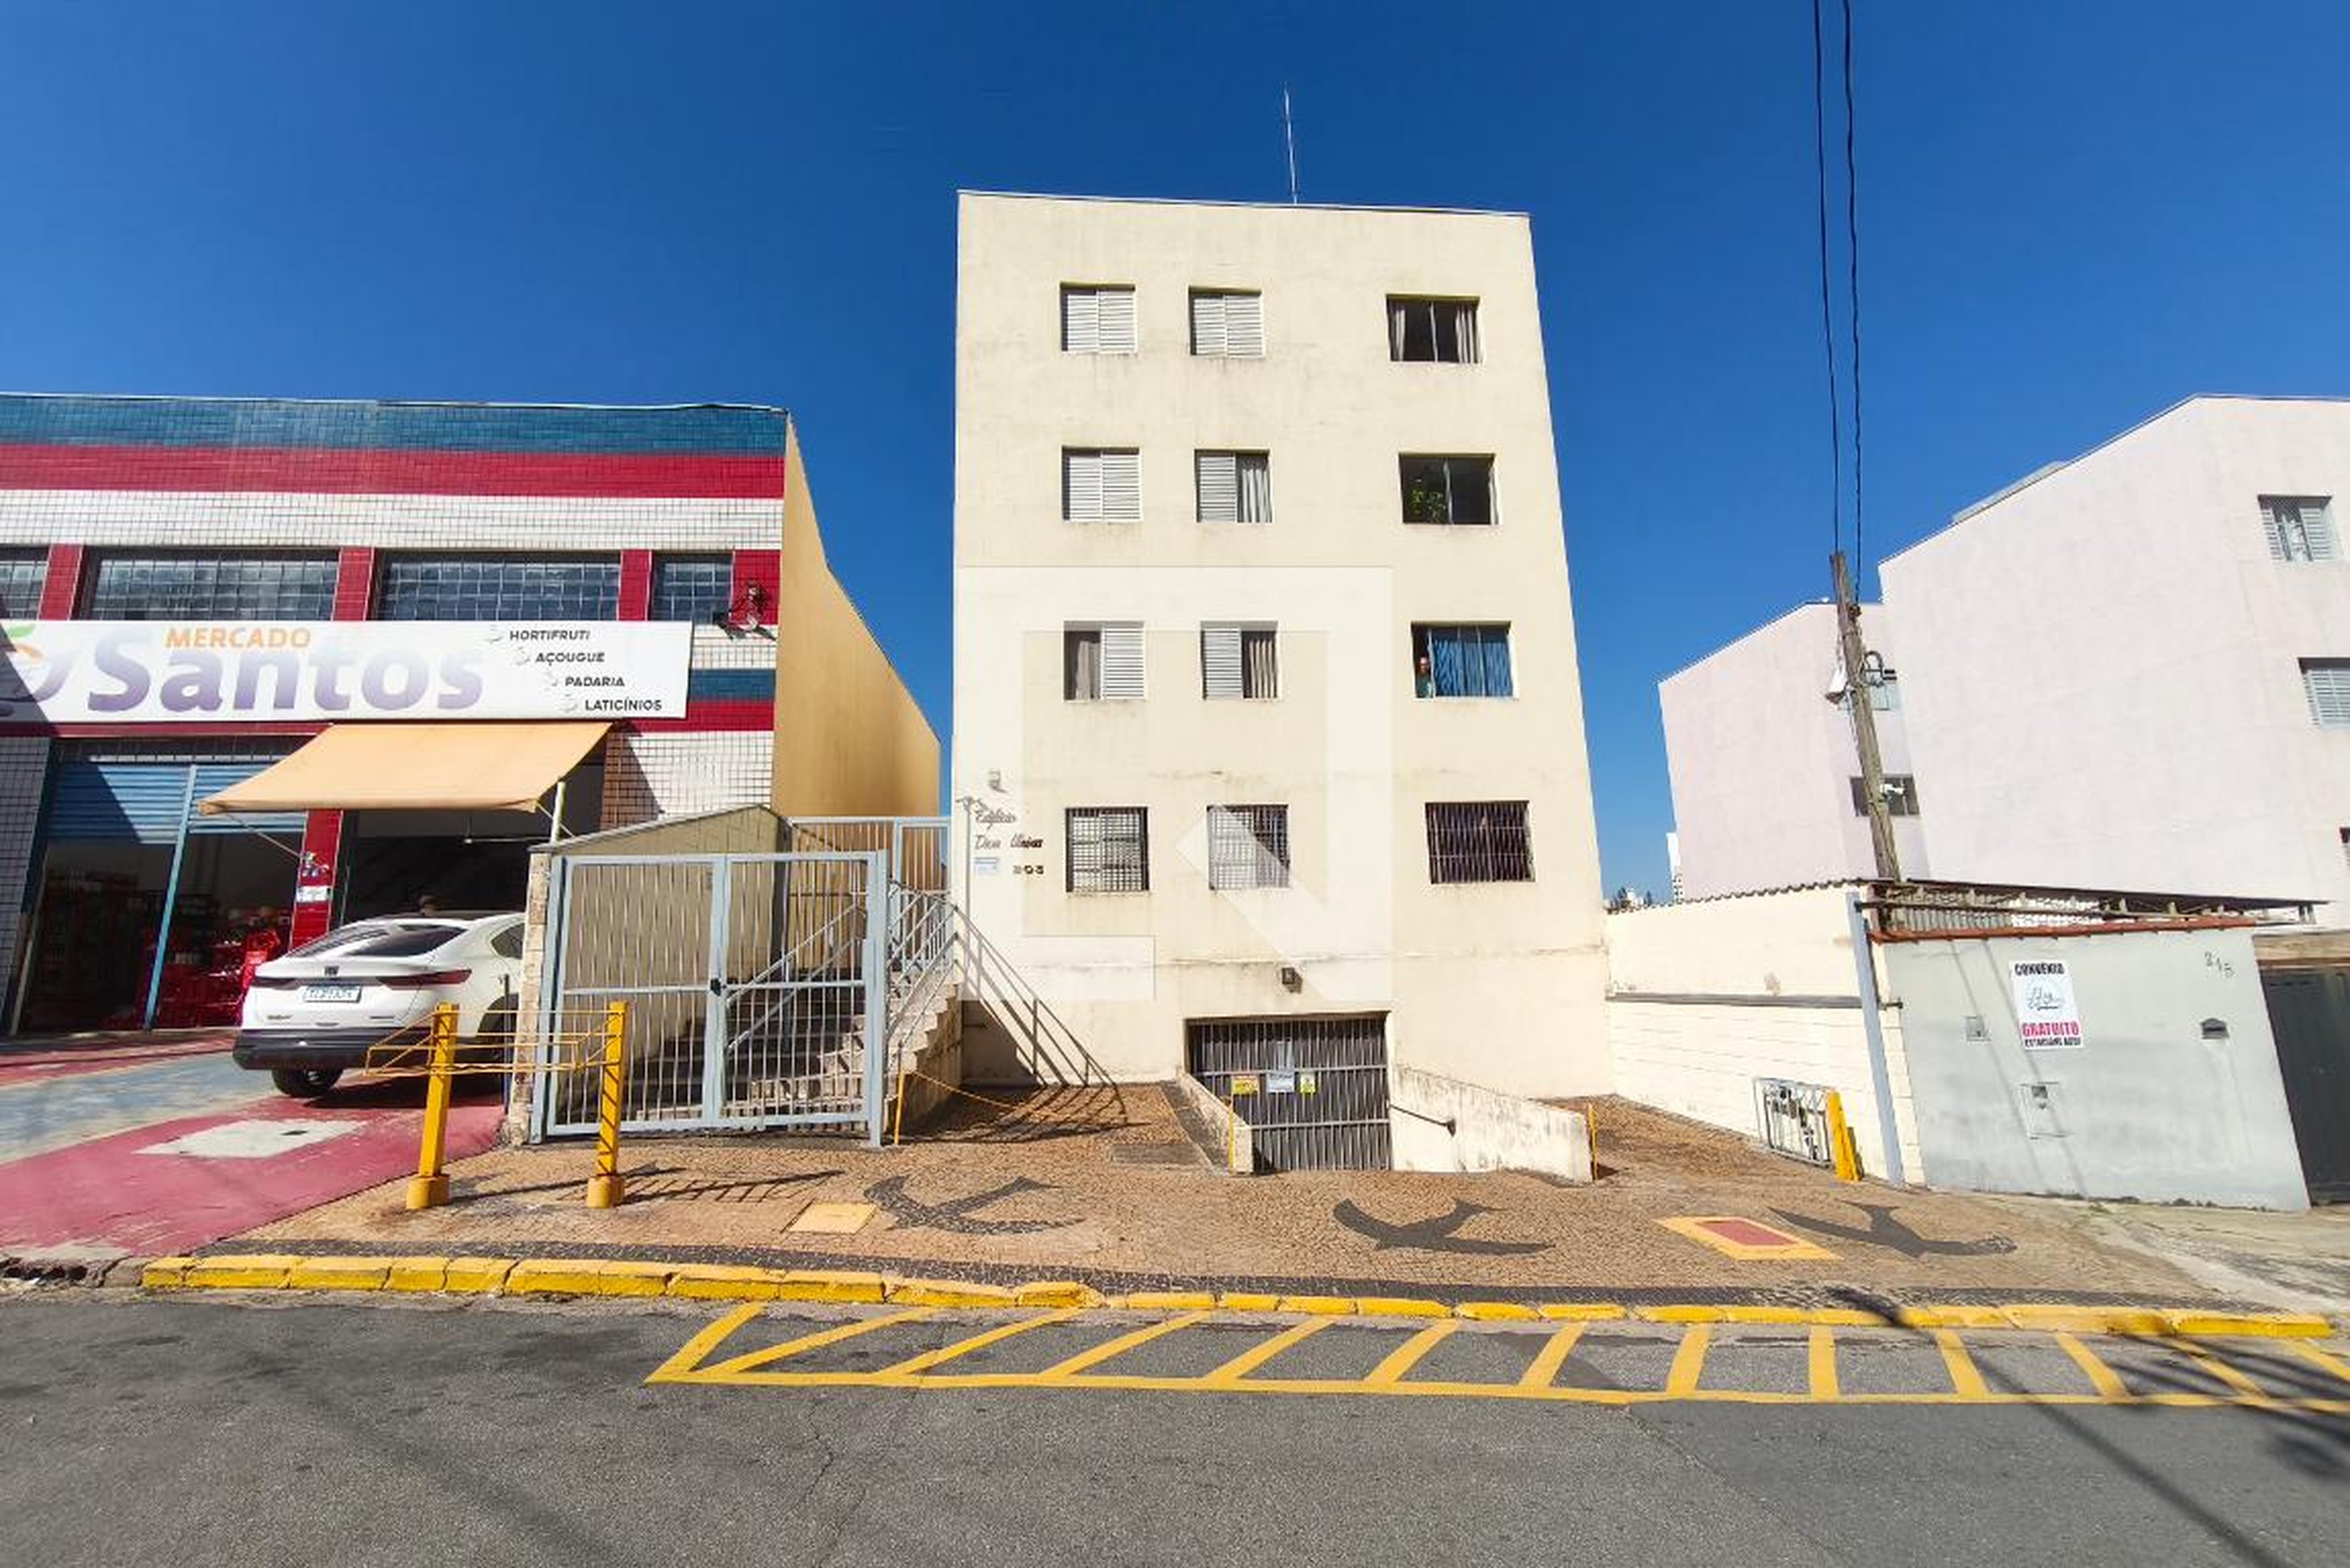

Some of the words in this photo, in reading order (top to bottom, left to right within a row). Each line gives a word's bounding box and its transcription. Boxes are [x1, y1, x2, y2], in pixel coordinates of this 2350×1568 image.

[164, 627, 311, 649] MERCADO
[509, 630, 591, 641] HORTIFRUTI
[535, 652, 605, 666] AÇOUGUE
[87, 628, 483, 712] Santos
[565, 676, 625, 687] PADARIA
[584, 696, 663, 711] LATICÍNIOS
[2022, 1021, 2080, 1037] GRATUITO
